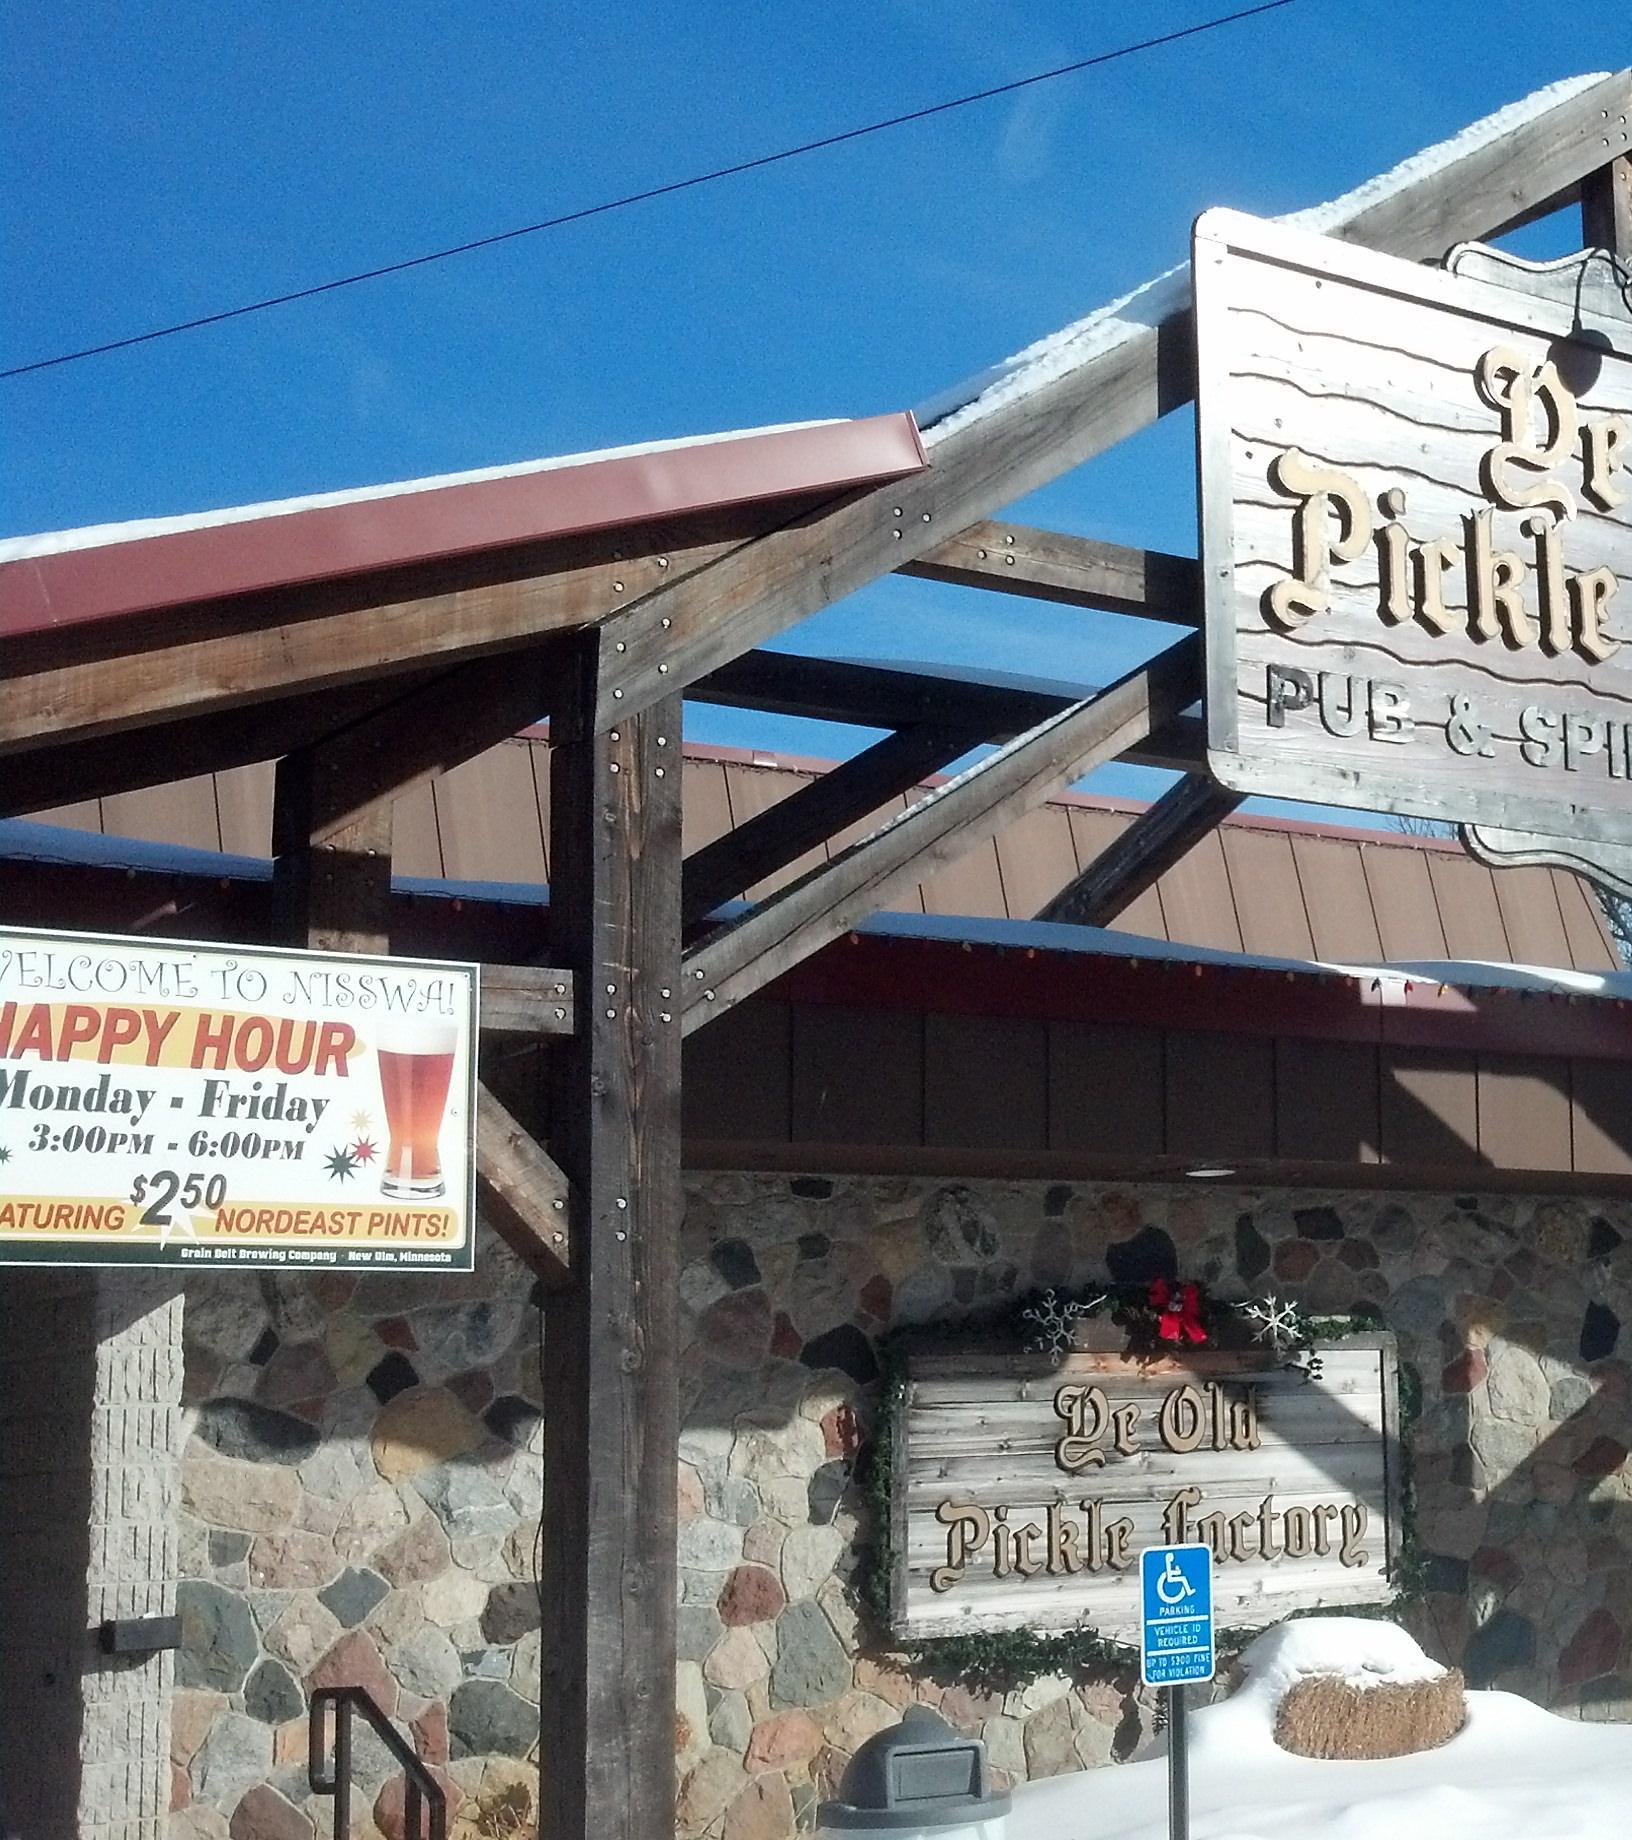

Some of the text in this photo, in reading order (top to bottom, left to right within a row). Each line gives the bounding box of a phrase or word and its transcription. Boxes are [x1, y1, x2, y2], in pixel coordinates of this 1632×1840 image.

[1478, 345, 1631, 523] Ye
[1261, 447, 1625, 662] Pickle
[1265, 663, 1415, 745] PUB
[1446, 693, 1496, 760] &
[210, 959, 268, 1002] TO
[282, 969, 456, 1016] NISSWA!
[190, 1012, 356, 1077] HOUR
[0, 1068, 157, 1126] Monday
[197, 1078, 331, 1133] Friday
[28, 1123, 155, 1155] 3:00PM
[188, 1129, 306, 1162] 6:00PM
[214, 1207, 363, 1236] NORDEAST
[366, 1211, 450, 1238] PINTS!
[180, 1247, 212, 1259] Grain
[239, 1249, 286, 1262] Brewing
[288, 1249, 337, 1263] Company
[348, 1251, 373, 1261] New
[399, 1251, 452, 1263] Minnesota
[1054, 1381, 1262, 1473] Ye Old
[929, 1486, 1370, 1594] Pickle Factory
[1154, 1623, 1201, 1636] VEHICLE ID
[1159, 1604, 1195, 1616] PARKING
[1146, 1658, 1156, 1668] UP
[1158, 1657, 1168, 1667] TO
[1194, 1653, 1211, 1663] FINE
[1157, 1635, 1198, 1647] REQUIRED
[1152, 1665, 1205, 1679] FOR VIOLATION
